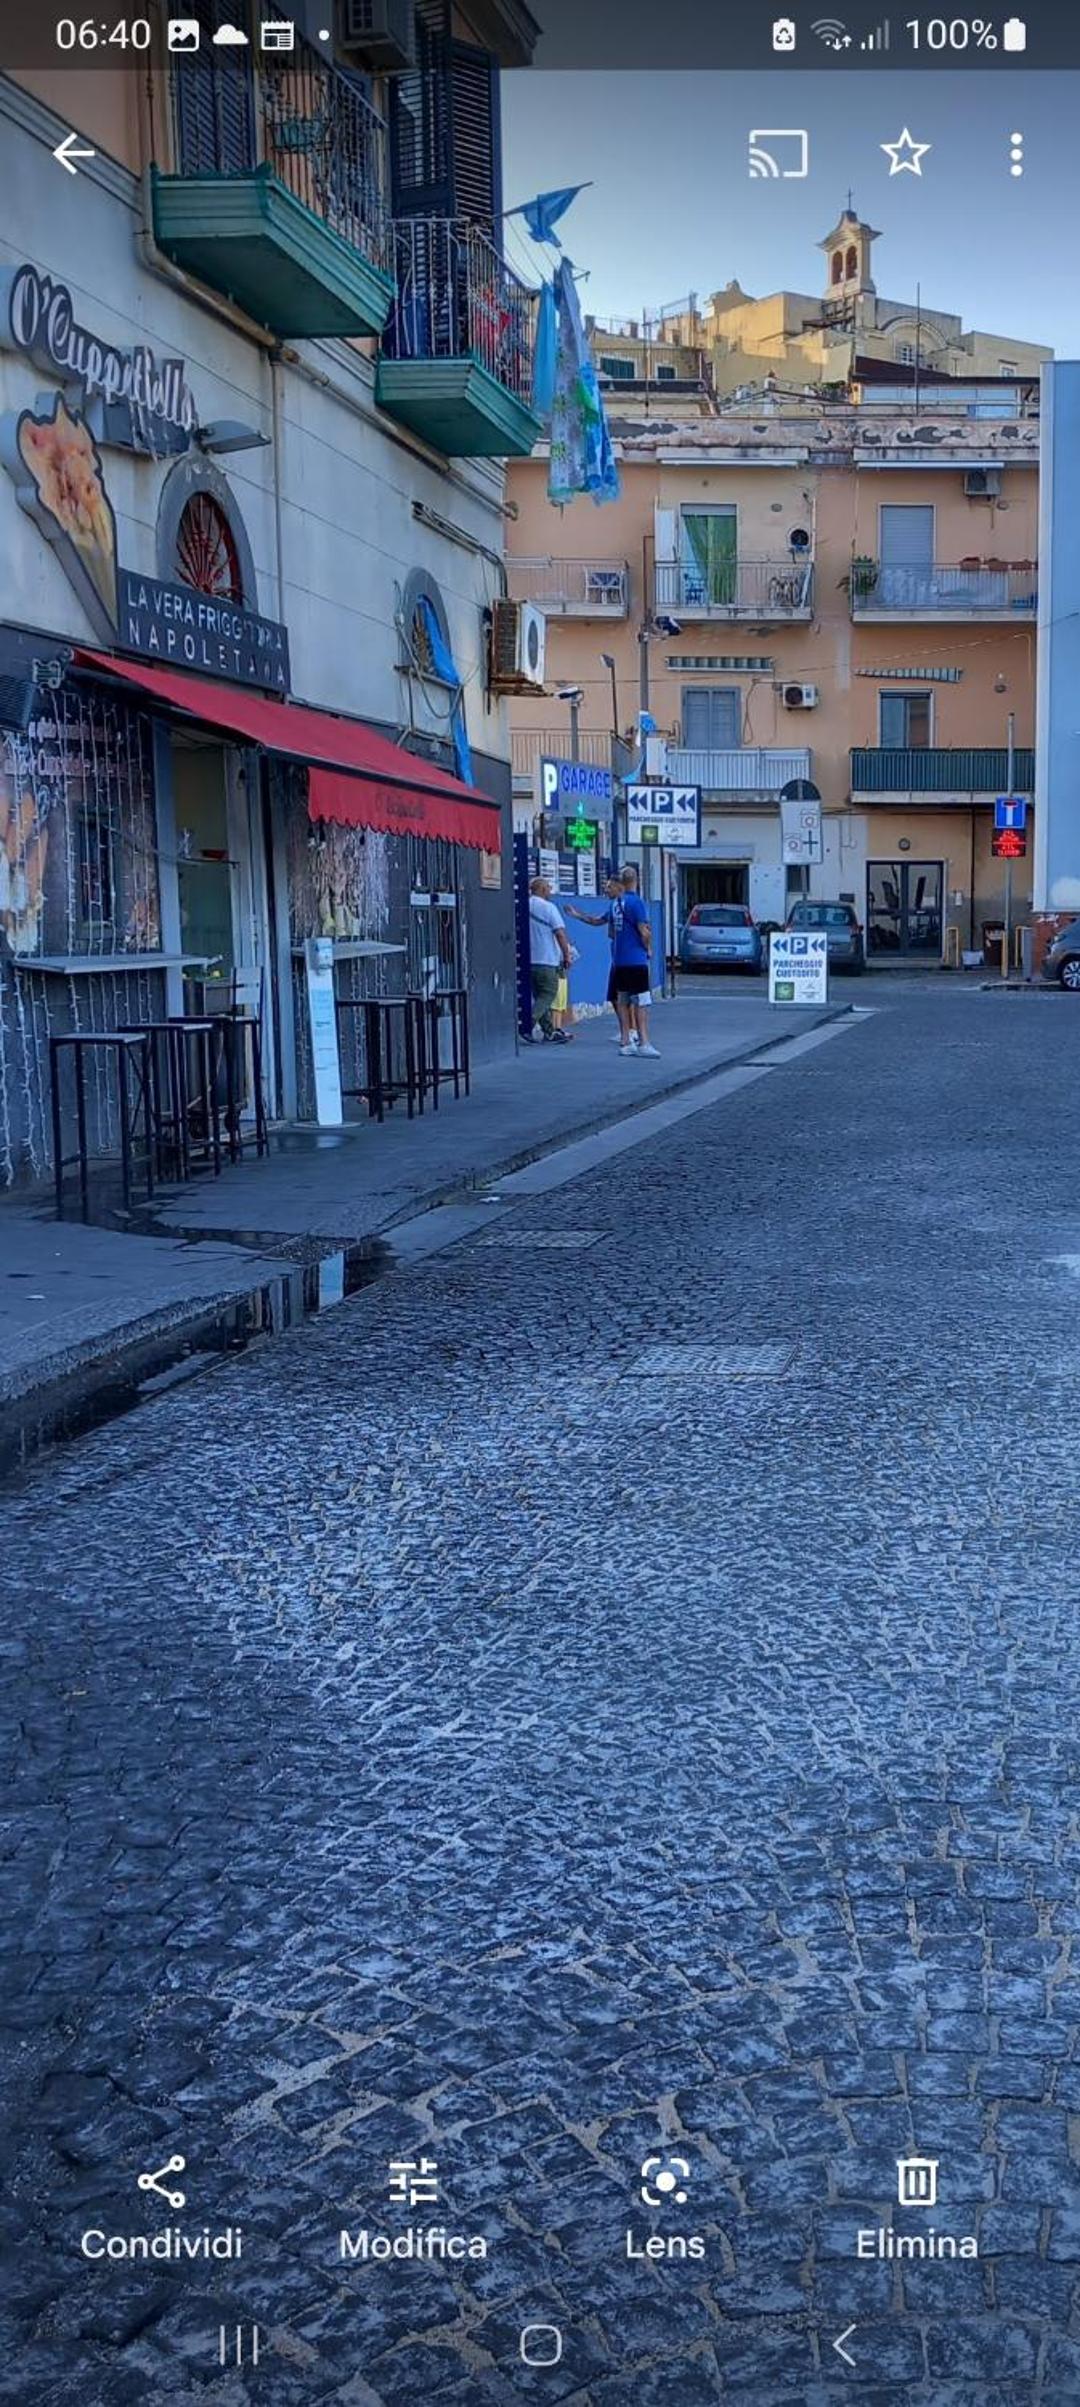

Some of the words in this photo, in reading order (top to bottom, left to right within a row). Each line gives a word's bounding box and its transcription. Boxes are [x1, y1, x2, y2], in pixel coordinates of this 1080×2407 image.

[127, 580, 148, 610] LA
[152, 589, 195, 627] VERA
[544, 762, 558, 806] P
[560, 765, 611, 799] GARAGE
[654, 792, 670, 812] P
[793, 938, 805, 954] P
